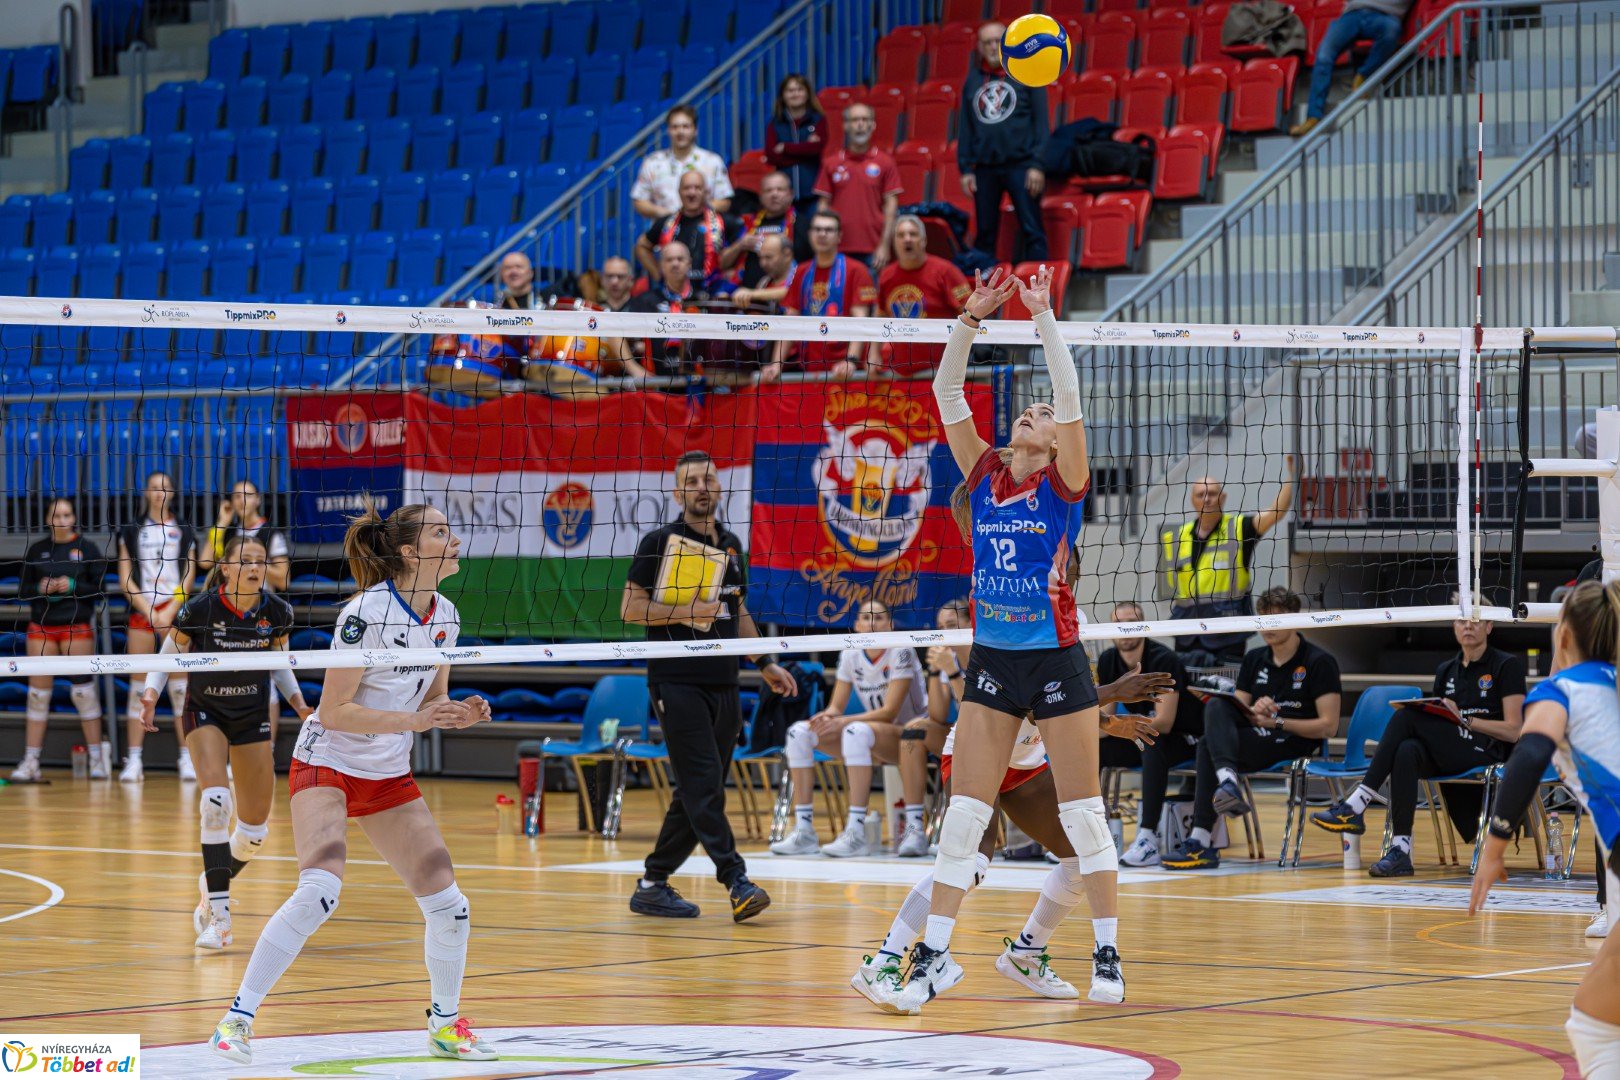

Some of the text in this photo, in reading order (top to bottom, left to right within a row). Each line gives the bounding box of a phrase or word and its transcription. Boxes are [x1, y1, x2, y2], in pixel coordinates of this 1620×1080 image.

[224, 309, 277, 322] TippmixPRO
[485, 316, 534, 328] TippmixPRO
[725, 321, 770, 333] TippmixPRO
[1152, 329, 1190, 340] TippmixPRO
[427, 494, 517, 534] ASAS
[989, 537, 1018, 572] 12
[977, 569, 1041, 594] FATUM
[213, 638, 270, 649] TippmixPRO
[203, 684, 259, 696] ALPROSYS
